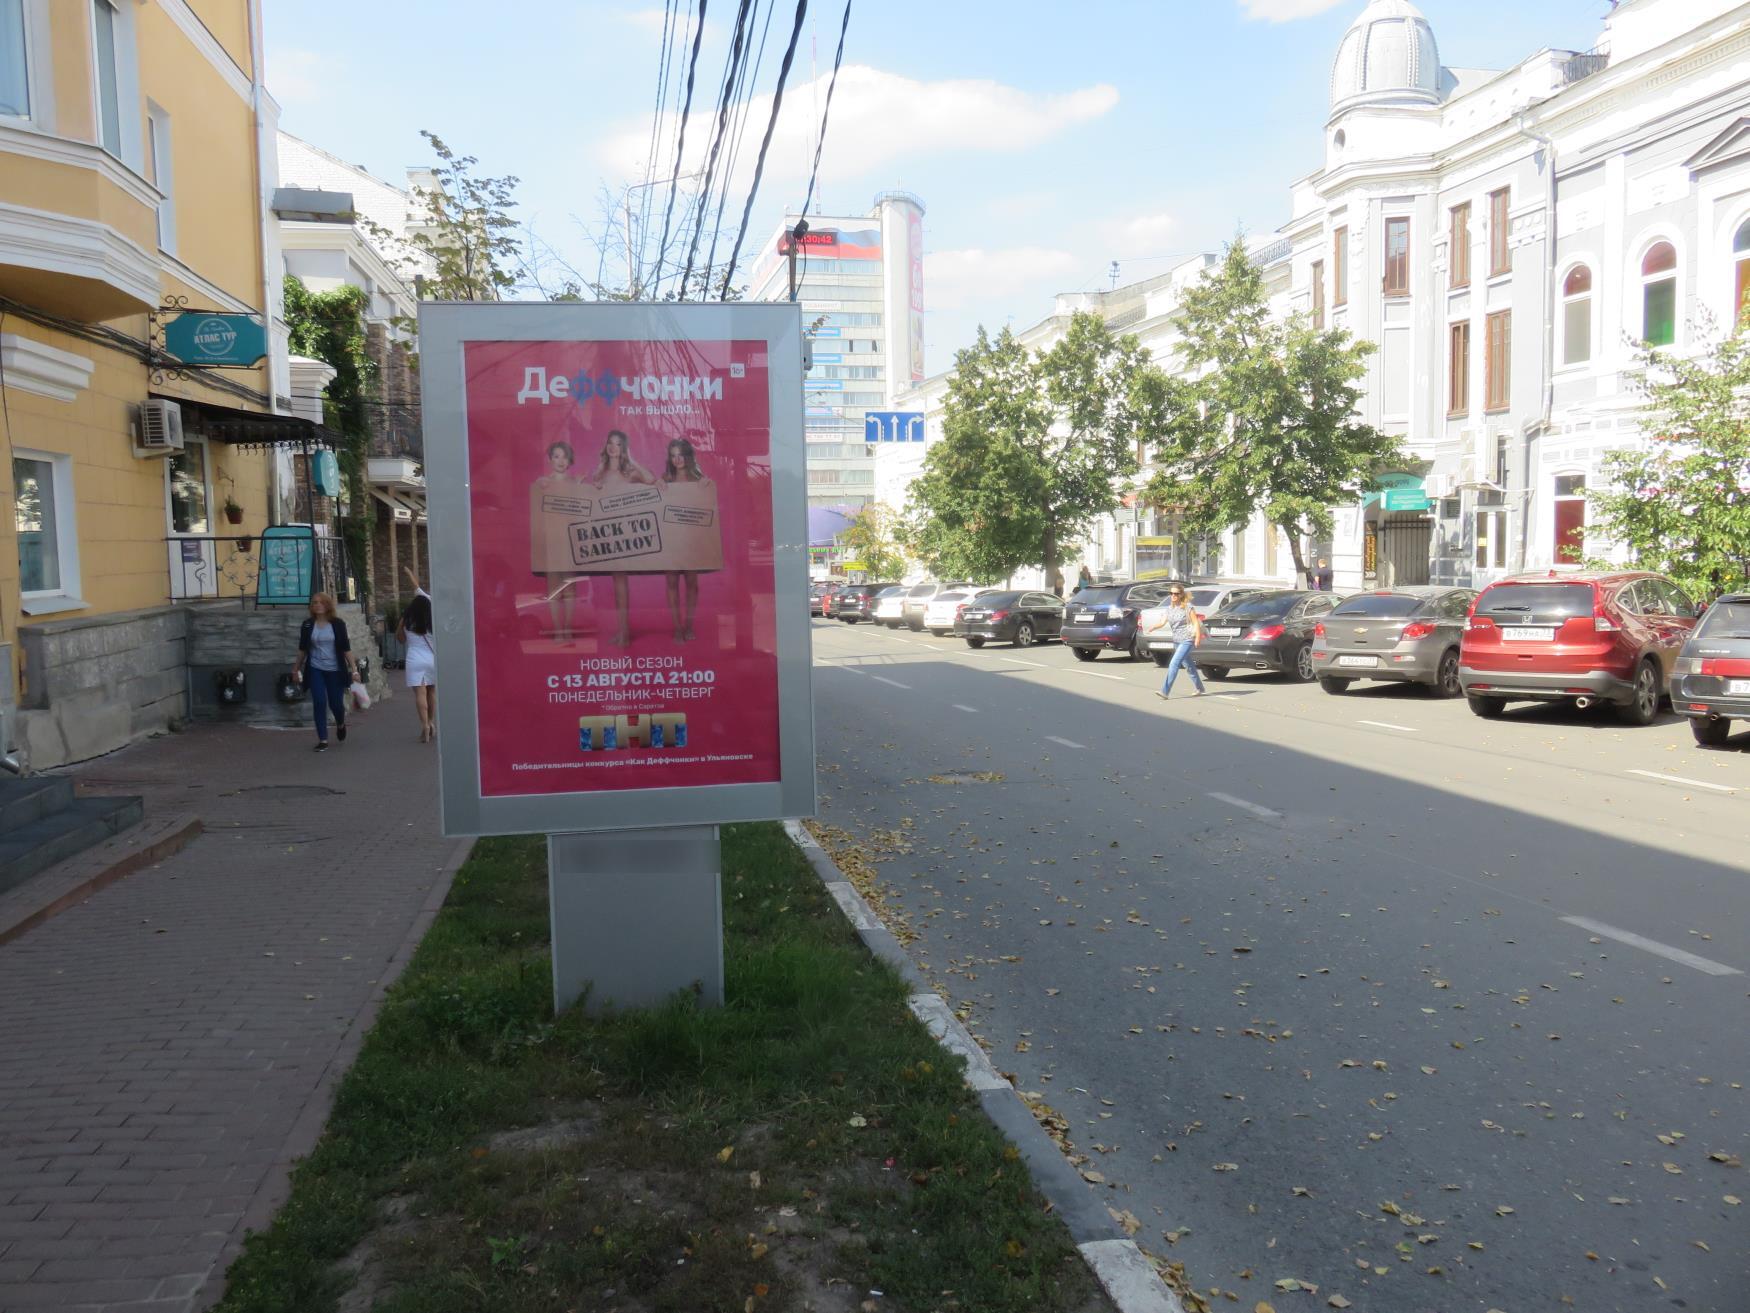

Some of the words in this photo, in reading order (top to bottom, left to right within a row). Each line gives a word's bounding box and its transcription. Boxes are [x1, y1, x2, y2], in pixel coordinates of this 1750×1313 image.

[193, 333, 220, 344] АТЛАС
[221, 331, 237, 342] ТУР
[517, 366, 724, 408] Деффчонки
[619, 406, 643, 415] ТАК
[576, 521, 624, 542] BACK
[628, 518, 651, 533] TO
[579, 535, 656, 559] SARATOV
[580, 656, 632, 671] НОВЫЙ
[636, 656, 684, 669] СЕЗОН
[546, 675, 559, 688] С
[562, 674, 583, 688] 13
[586, 671, 666, 687] АВГУСТА
[668, 670, 715, 685] 21:00
[548, 687, 715, 704] ПОНЕДЕЛЬНИК-ЧЕТВЕРГ
[579, 713, 688, 751] ТНТ
[511, 762, 584, 772] Победительницы
[586, 760, 625, 769] конкурса
[625, 758, 646, 767] «Как
[647, 755, 699, 766] Деффчонки»
[707, 753, 754, 762] Ульяновске
